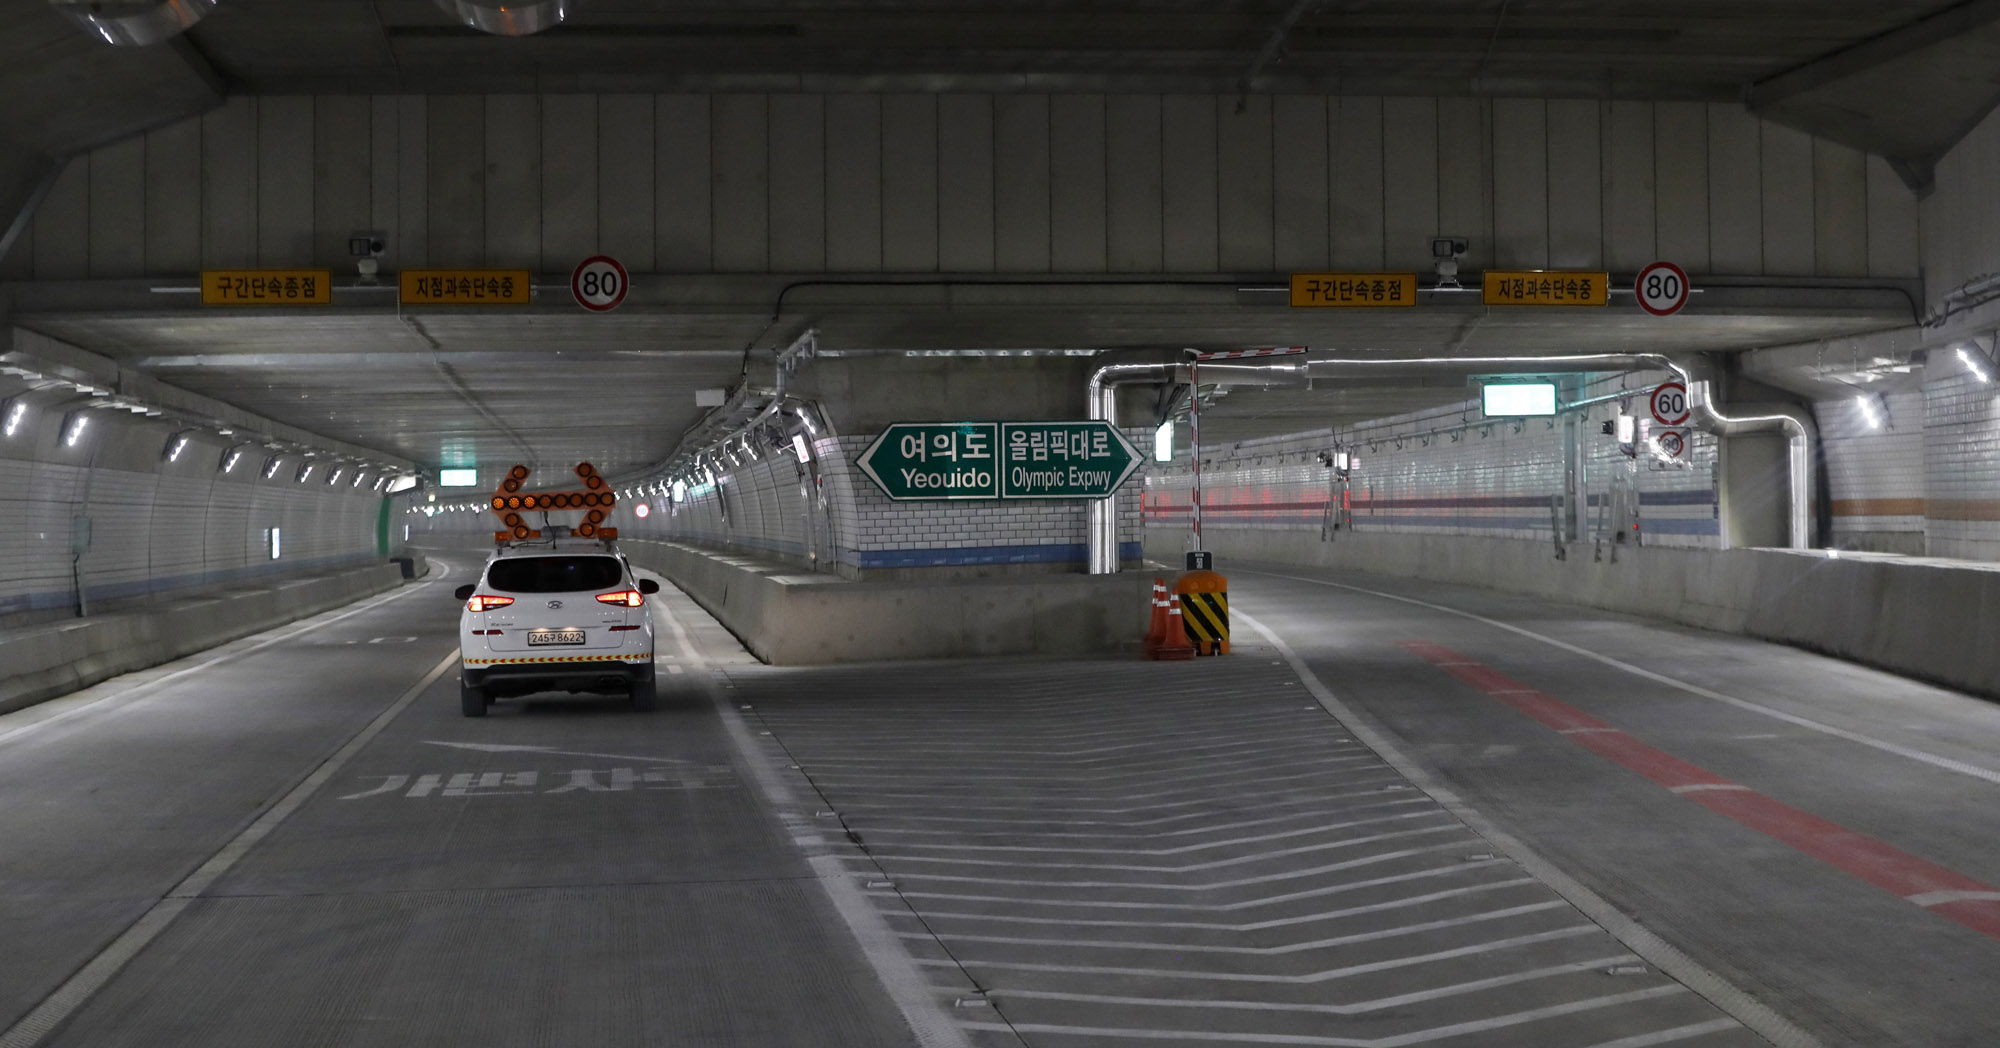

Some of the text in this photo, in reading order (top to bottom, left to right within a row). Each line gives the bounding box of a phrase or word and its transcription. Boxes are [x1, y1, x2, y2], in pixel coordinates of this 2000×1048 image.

[217, 276, 316, 299] 구간단속종점
[416, 276, 514, 299] 지점과속단속중
[583, 271, 617, 297] 80
[1306, 279, 1402, 302] 구간단속종점
[1499, 278, 1591, 300] 지점과속단속중
[1646, 275, 1679, 300] 80
[1658, 394, 1684, 414] 60
[900, 431, 991, 462] 여의도
[1009, 430, 1111, 461] 올림픽대로
[900, 467, 991, 488] Yeouido
[1012, 466, 1111, 491] Olympic Expwy
[557, 632, 581, 642] 8622
